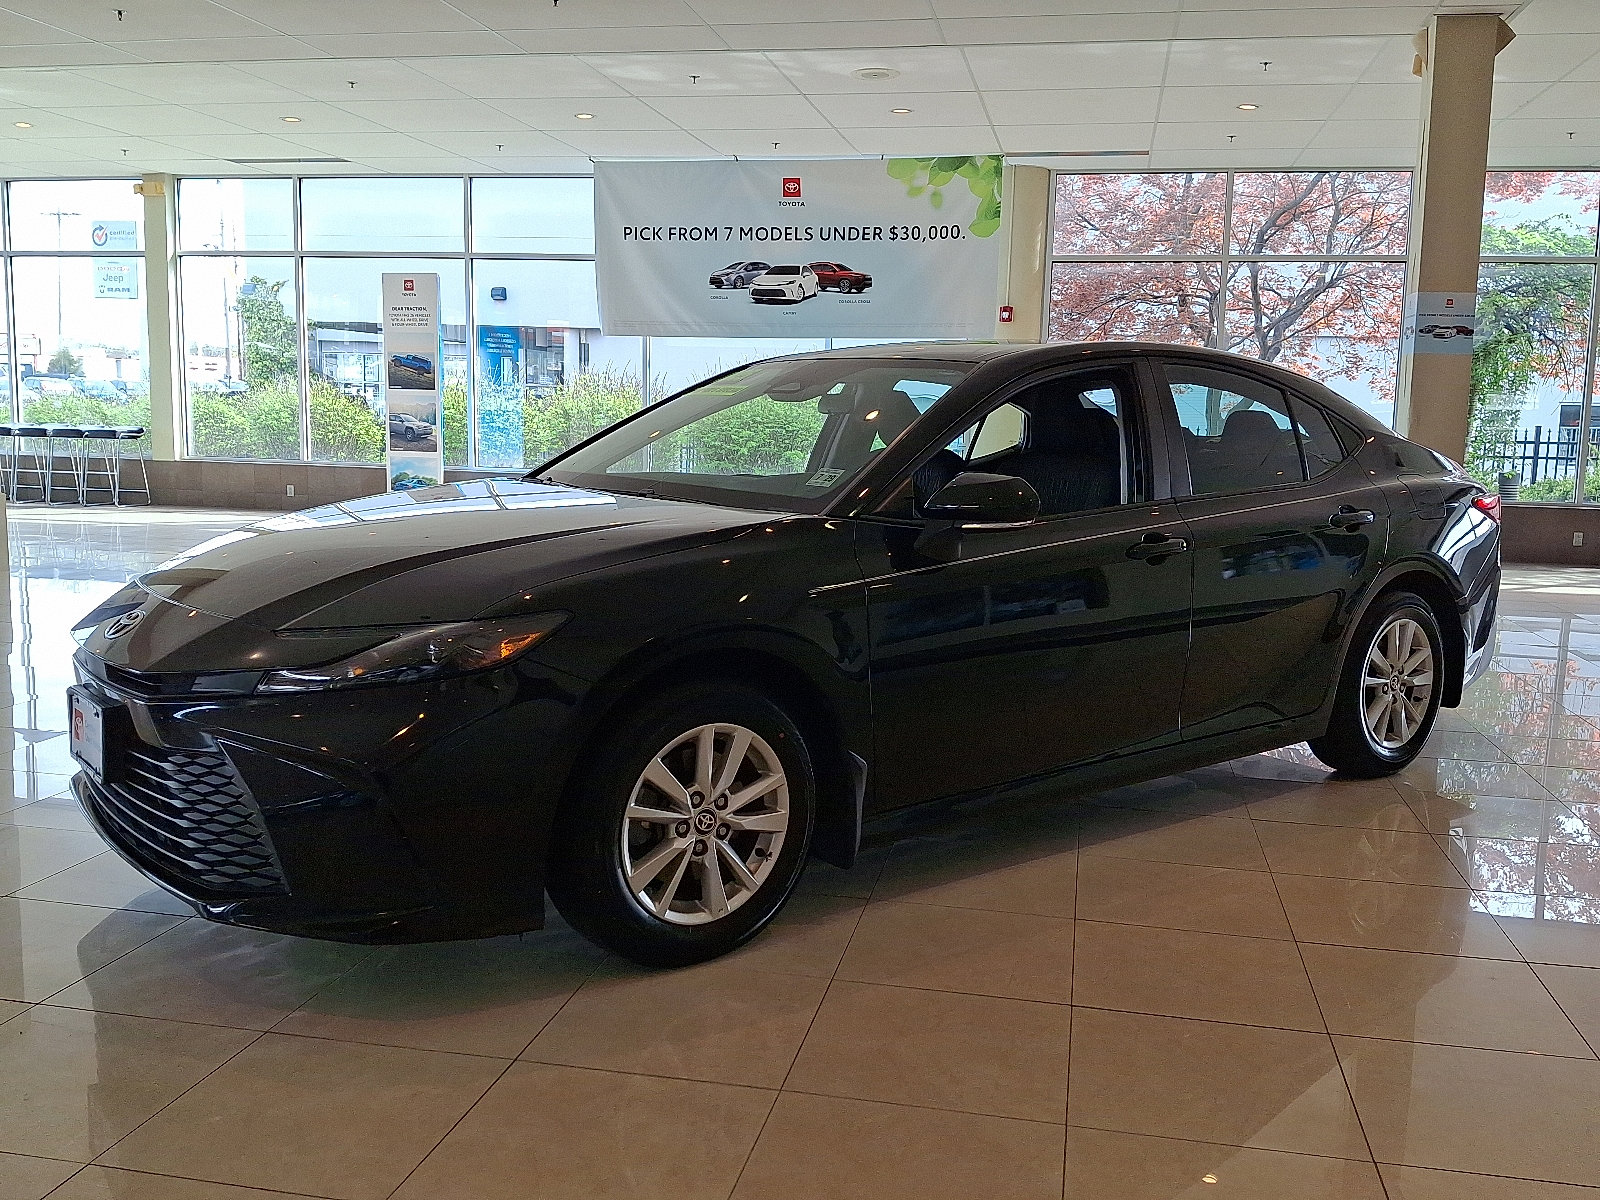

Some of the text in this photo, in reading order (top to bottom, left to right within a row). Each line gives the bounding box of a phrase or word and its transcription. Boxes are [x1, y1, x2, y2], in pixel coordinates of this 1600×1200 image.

[623, 225, 966, 243] PICK FROM 7 MODELS UNDER $30,000.
[102, 273, 124, 283] Jeep
